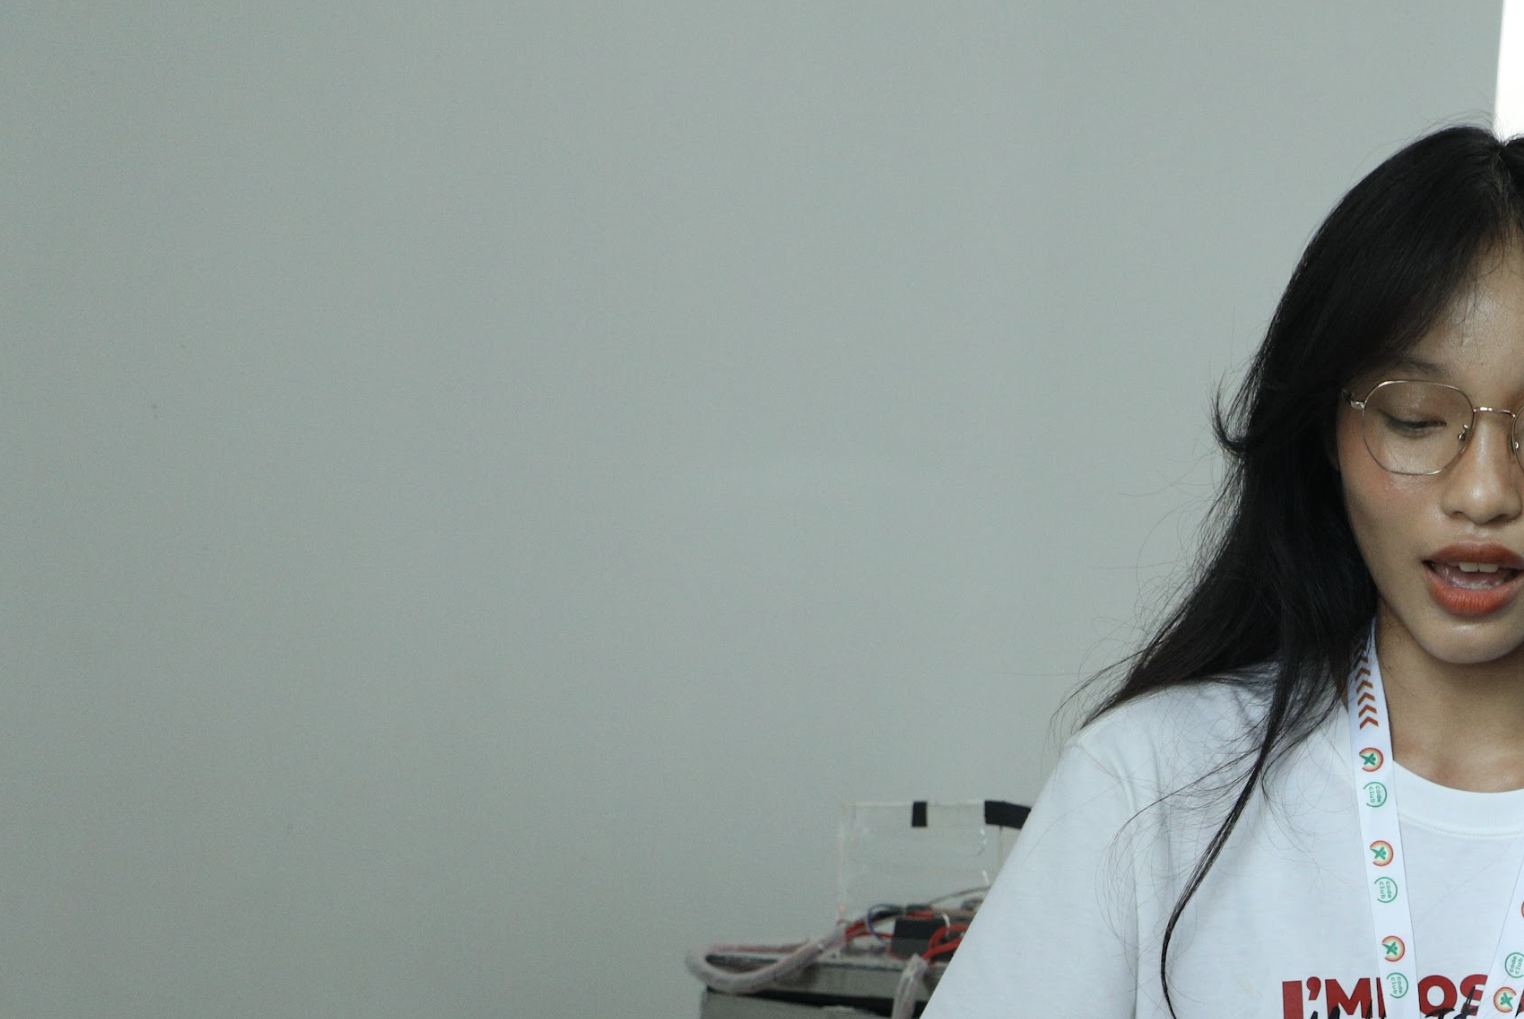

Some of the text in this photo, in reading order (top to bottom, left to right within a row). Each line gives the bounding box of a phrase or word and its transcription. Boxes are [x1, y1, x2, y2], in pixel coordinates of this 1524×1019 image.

[1368, 786, 1376, 804] club
[1385, 880, 1393, 899] code
[1509, 955, 1518, 973] code
[1515, 957, 1524, 975] club
